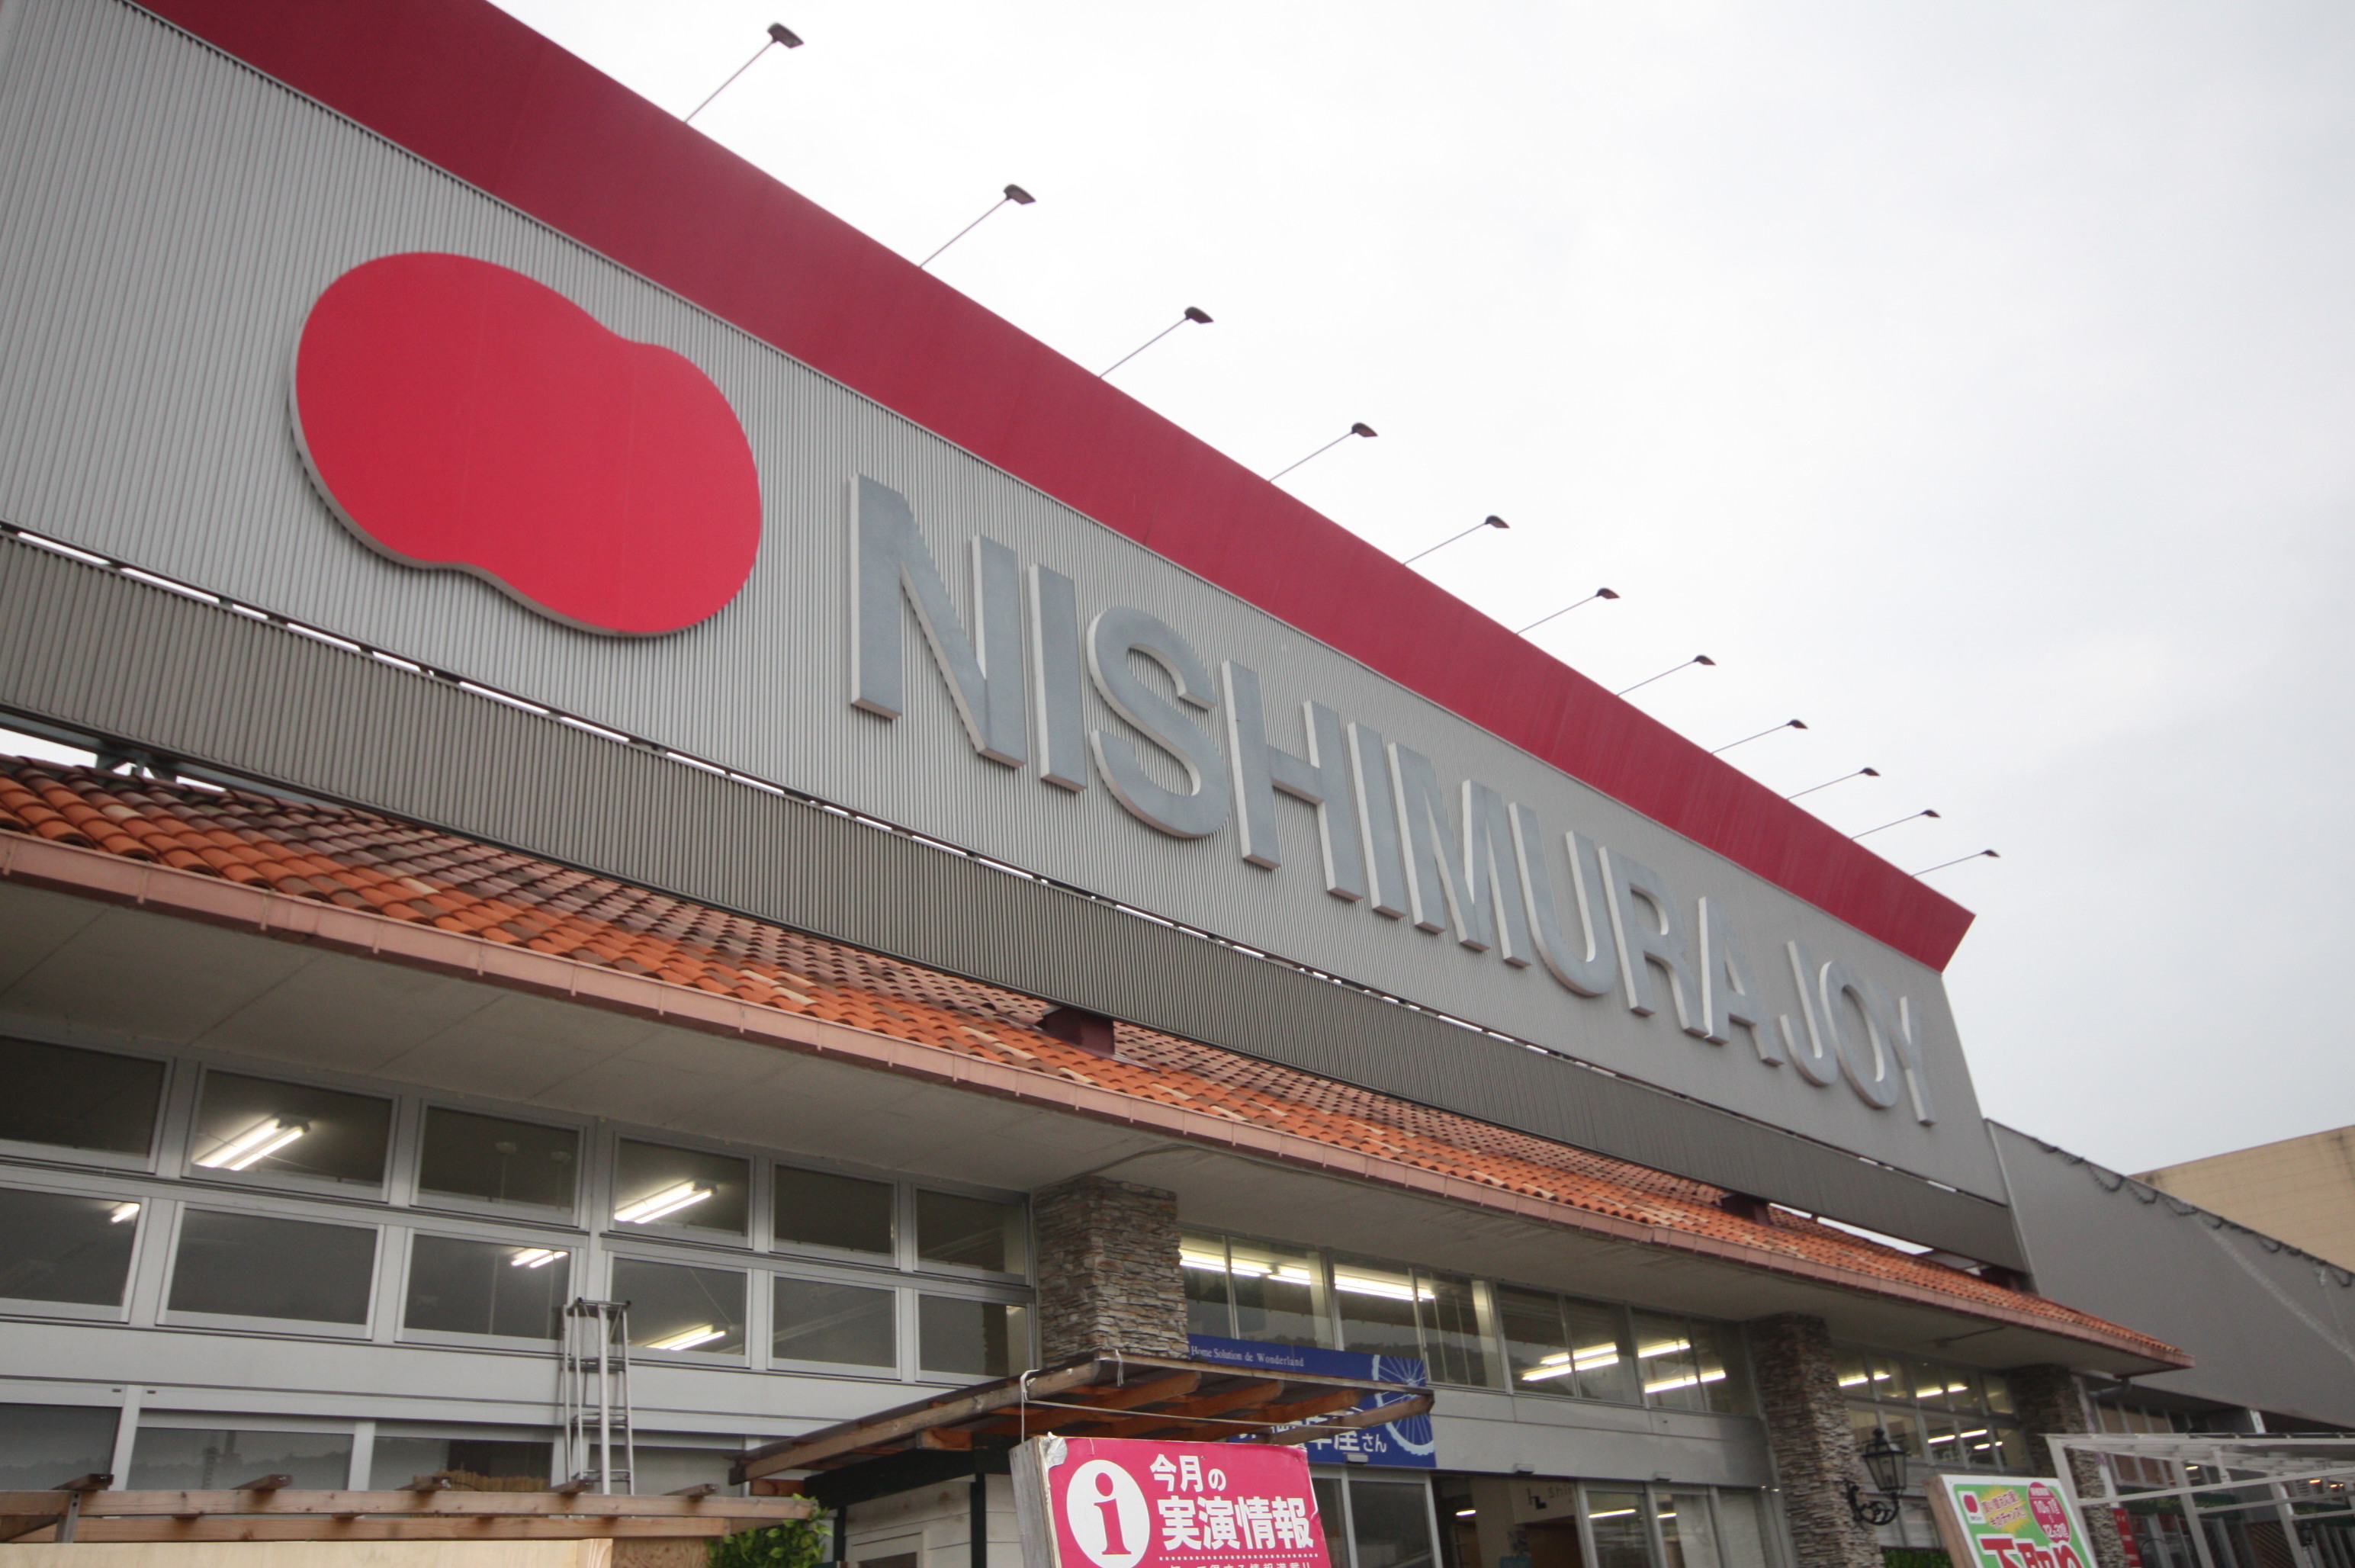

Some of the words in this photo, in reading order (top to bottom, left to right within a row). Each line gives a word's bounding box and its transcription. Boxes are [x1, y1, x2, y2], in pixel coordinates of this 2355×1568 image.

[850, 472, 1783, 1068] NISHIMURA
[1779, 940, 1937, 1126] JOY
[1191, 1345, 1213, 1358] Home
[1213, 1348, 1242, 1361] Solution
[1257, 1353, 1305, 1367] Wonderland
[1149, 1453, 1227, 1492] 今月の
[1156, 1495, 1313, 1550] 実演情報
